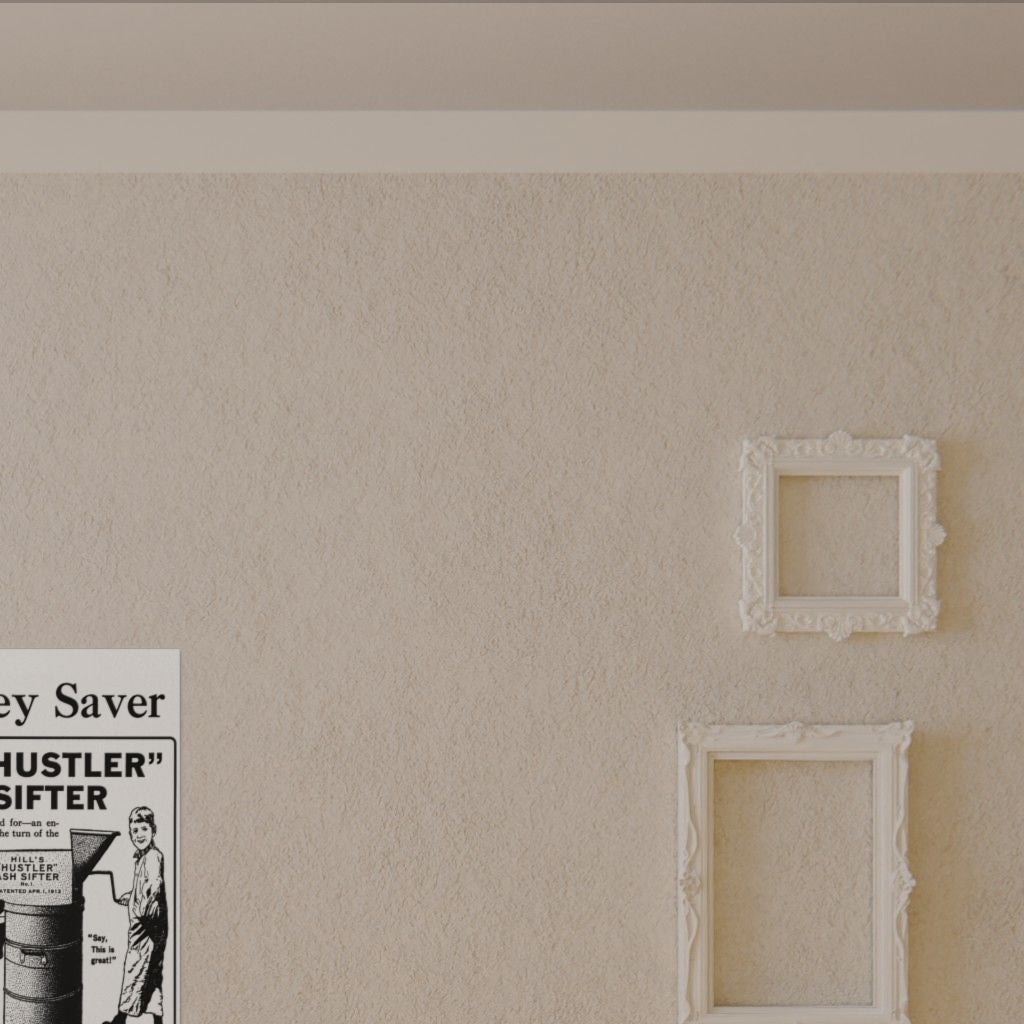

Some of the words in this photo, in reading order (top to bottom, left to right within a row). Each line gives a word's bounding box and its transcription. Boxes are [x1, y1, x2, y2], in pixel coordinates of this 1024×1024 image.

[55, 683, 165, 718] Saver
[34, 829, 42, 837] of
[46, 829, 59, 837] the
[21, 872, 60, 881] SIFTER
